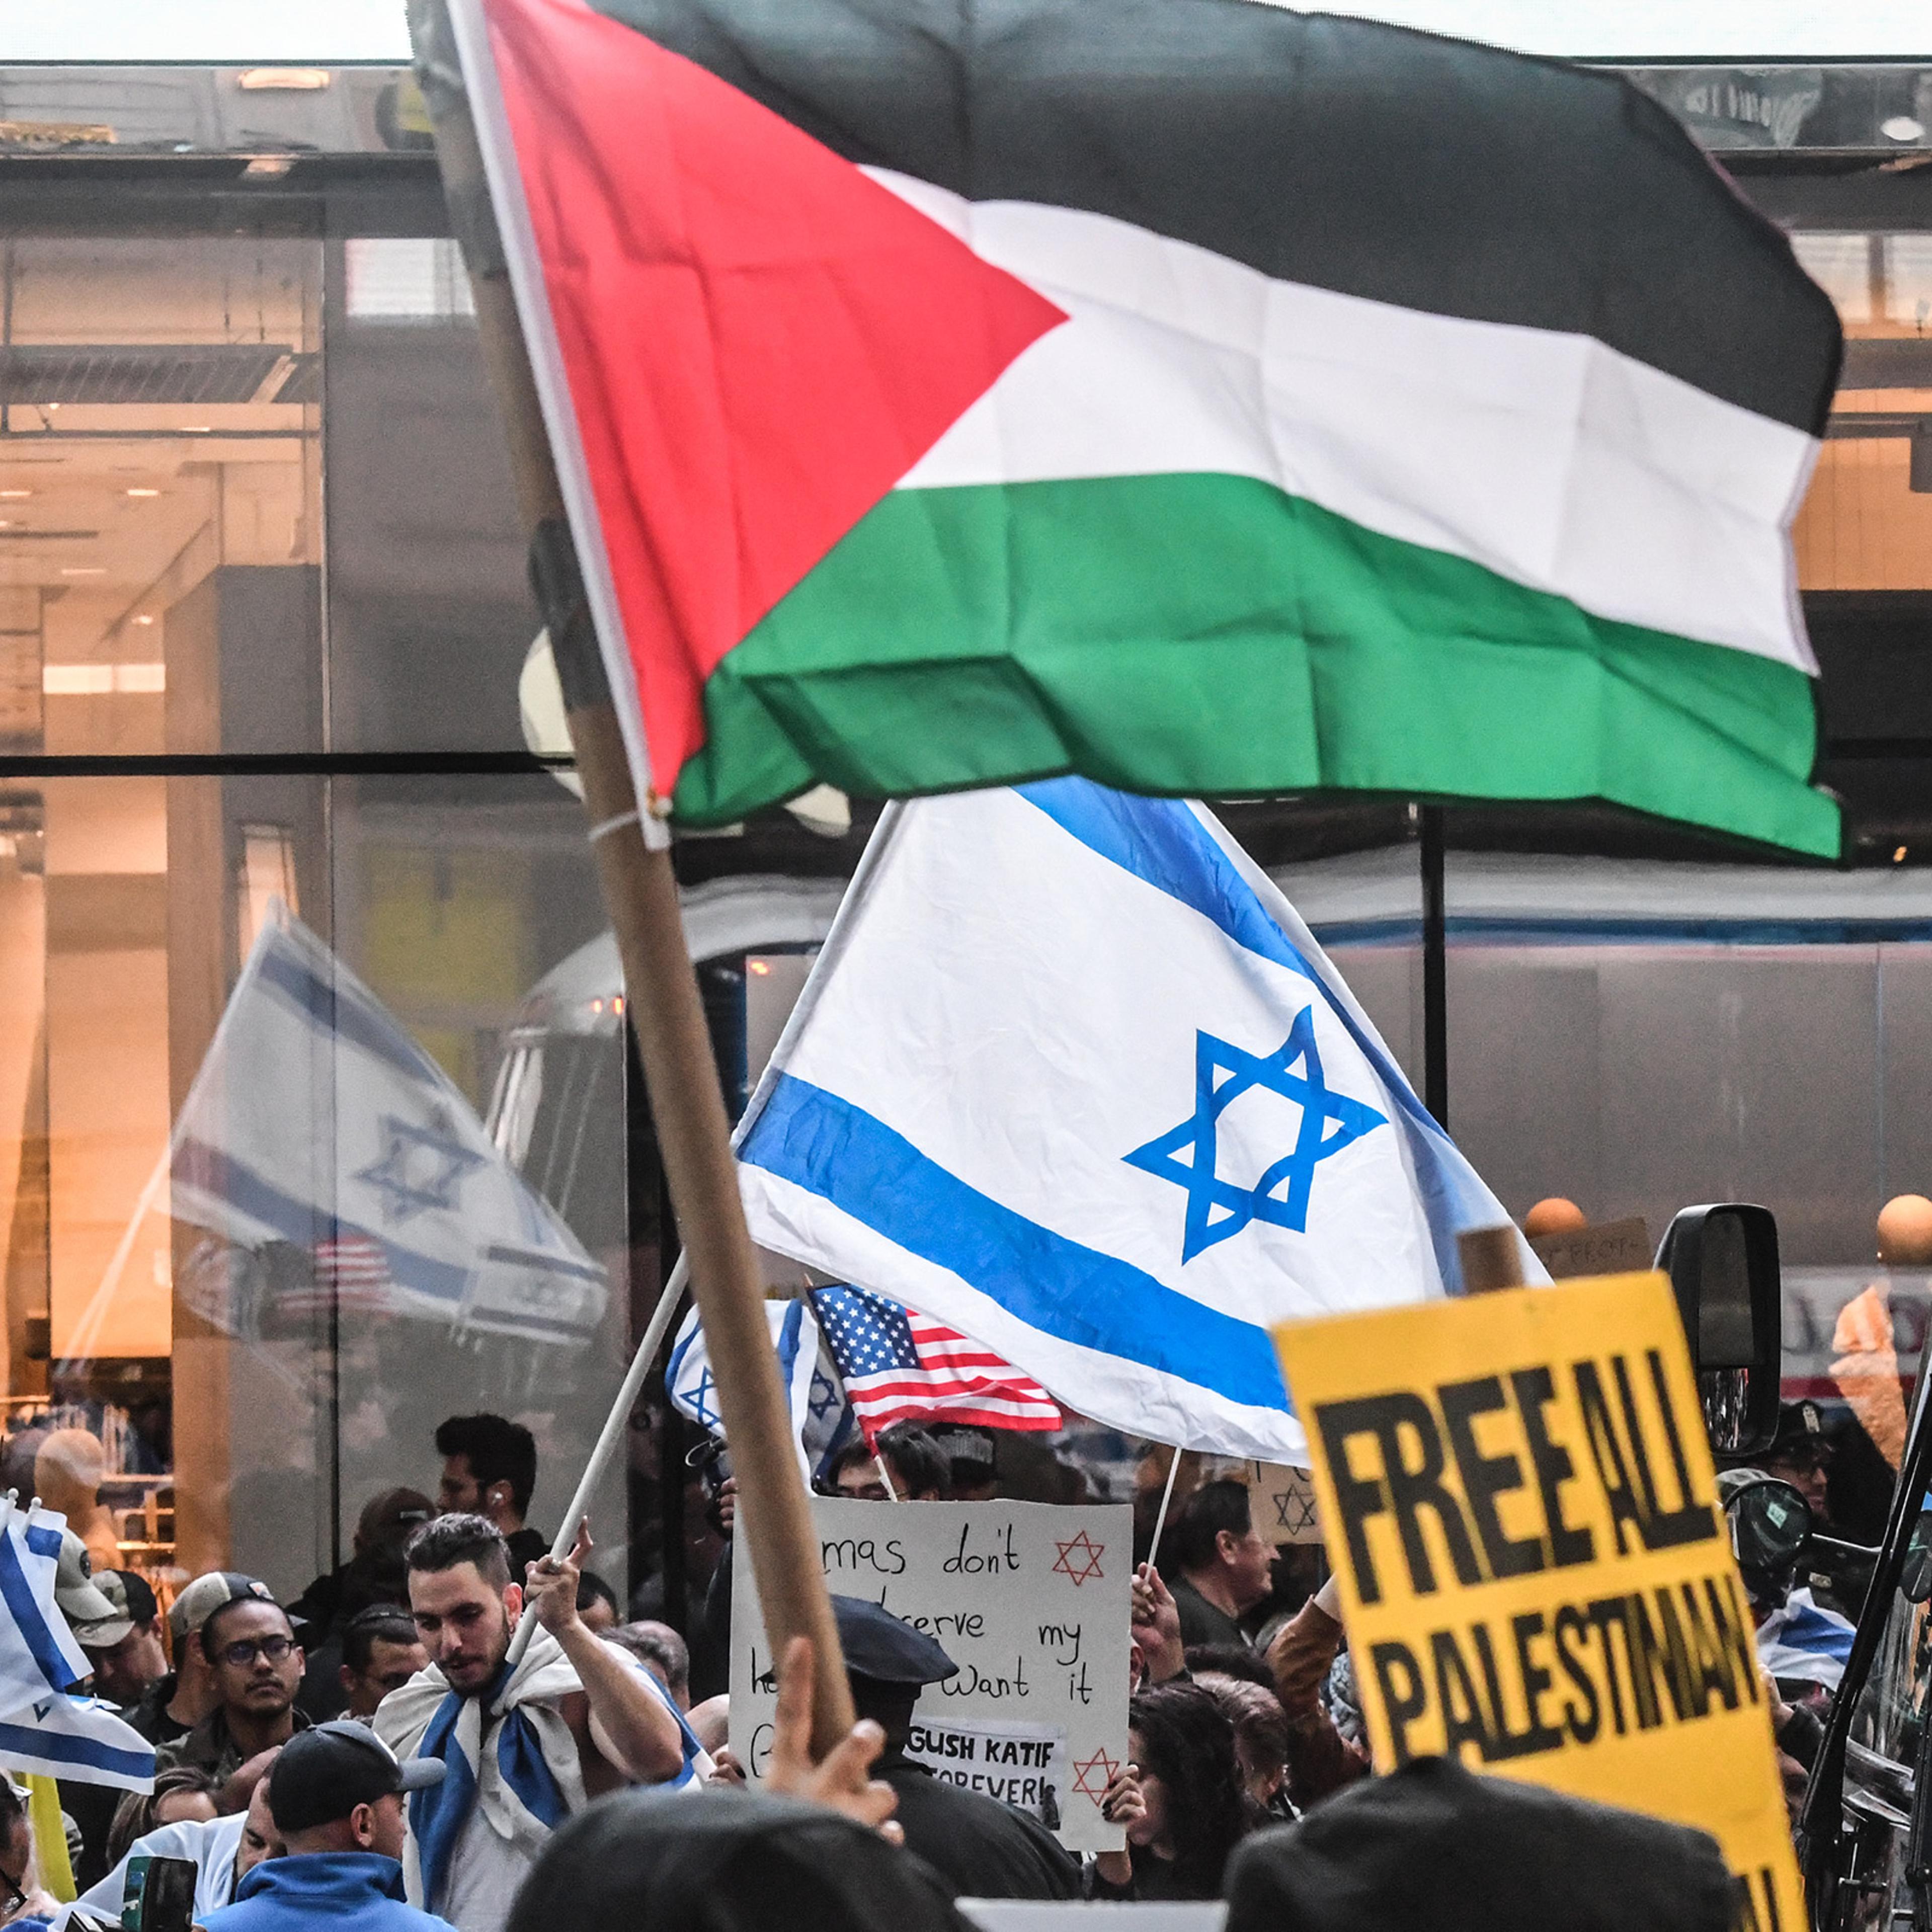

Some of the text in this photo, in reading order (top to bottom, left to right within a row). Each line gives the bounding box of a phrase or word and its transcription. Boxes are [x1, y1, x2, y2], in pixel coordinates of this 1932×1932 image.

[1314, 1347, 1720, 1607] FREE ALL
[821, 1522, 1020, 1575] mas don't
[1038, 1624, 1081, 1666] my
[1070, 1662, 1093, 1705] it
[906, 1725, 1055, 1768] GUSH KATIF
